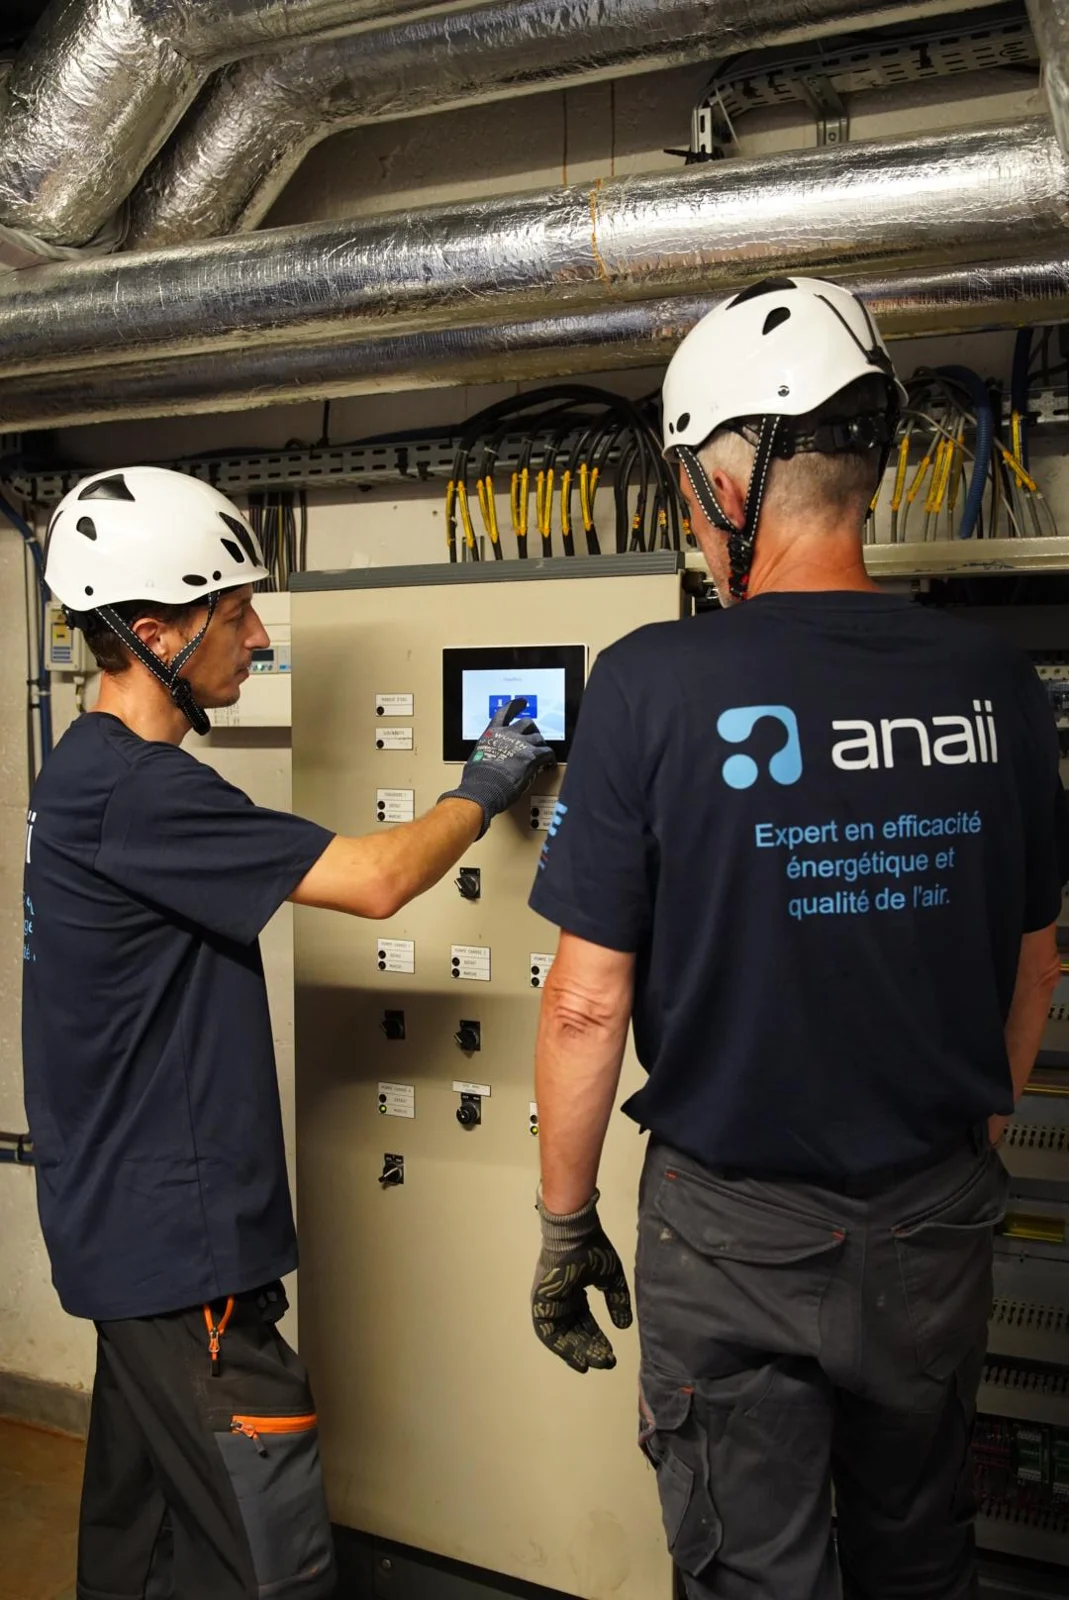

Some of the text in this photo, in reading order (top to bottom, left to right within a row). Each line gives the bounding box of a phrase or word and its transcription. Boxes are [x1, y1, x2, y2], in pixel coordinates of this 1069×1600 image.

[832, 699, 998, 770] anaii
[755, 811, 981, 850] Expert en efficacité
[786, 848, 954, 881] énergétique et
[789, 884, 950, 920] qualité de l'air.
